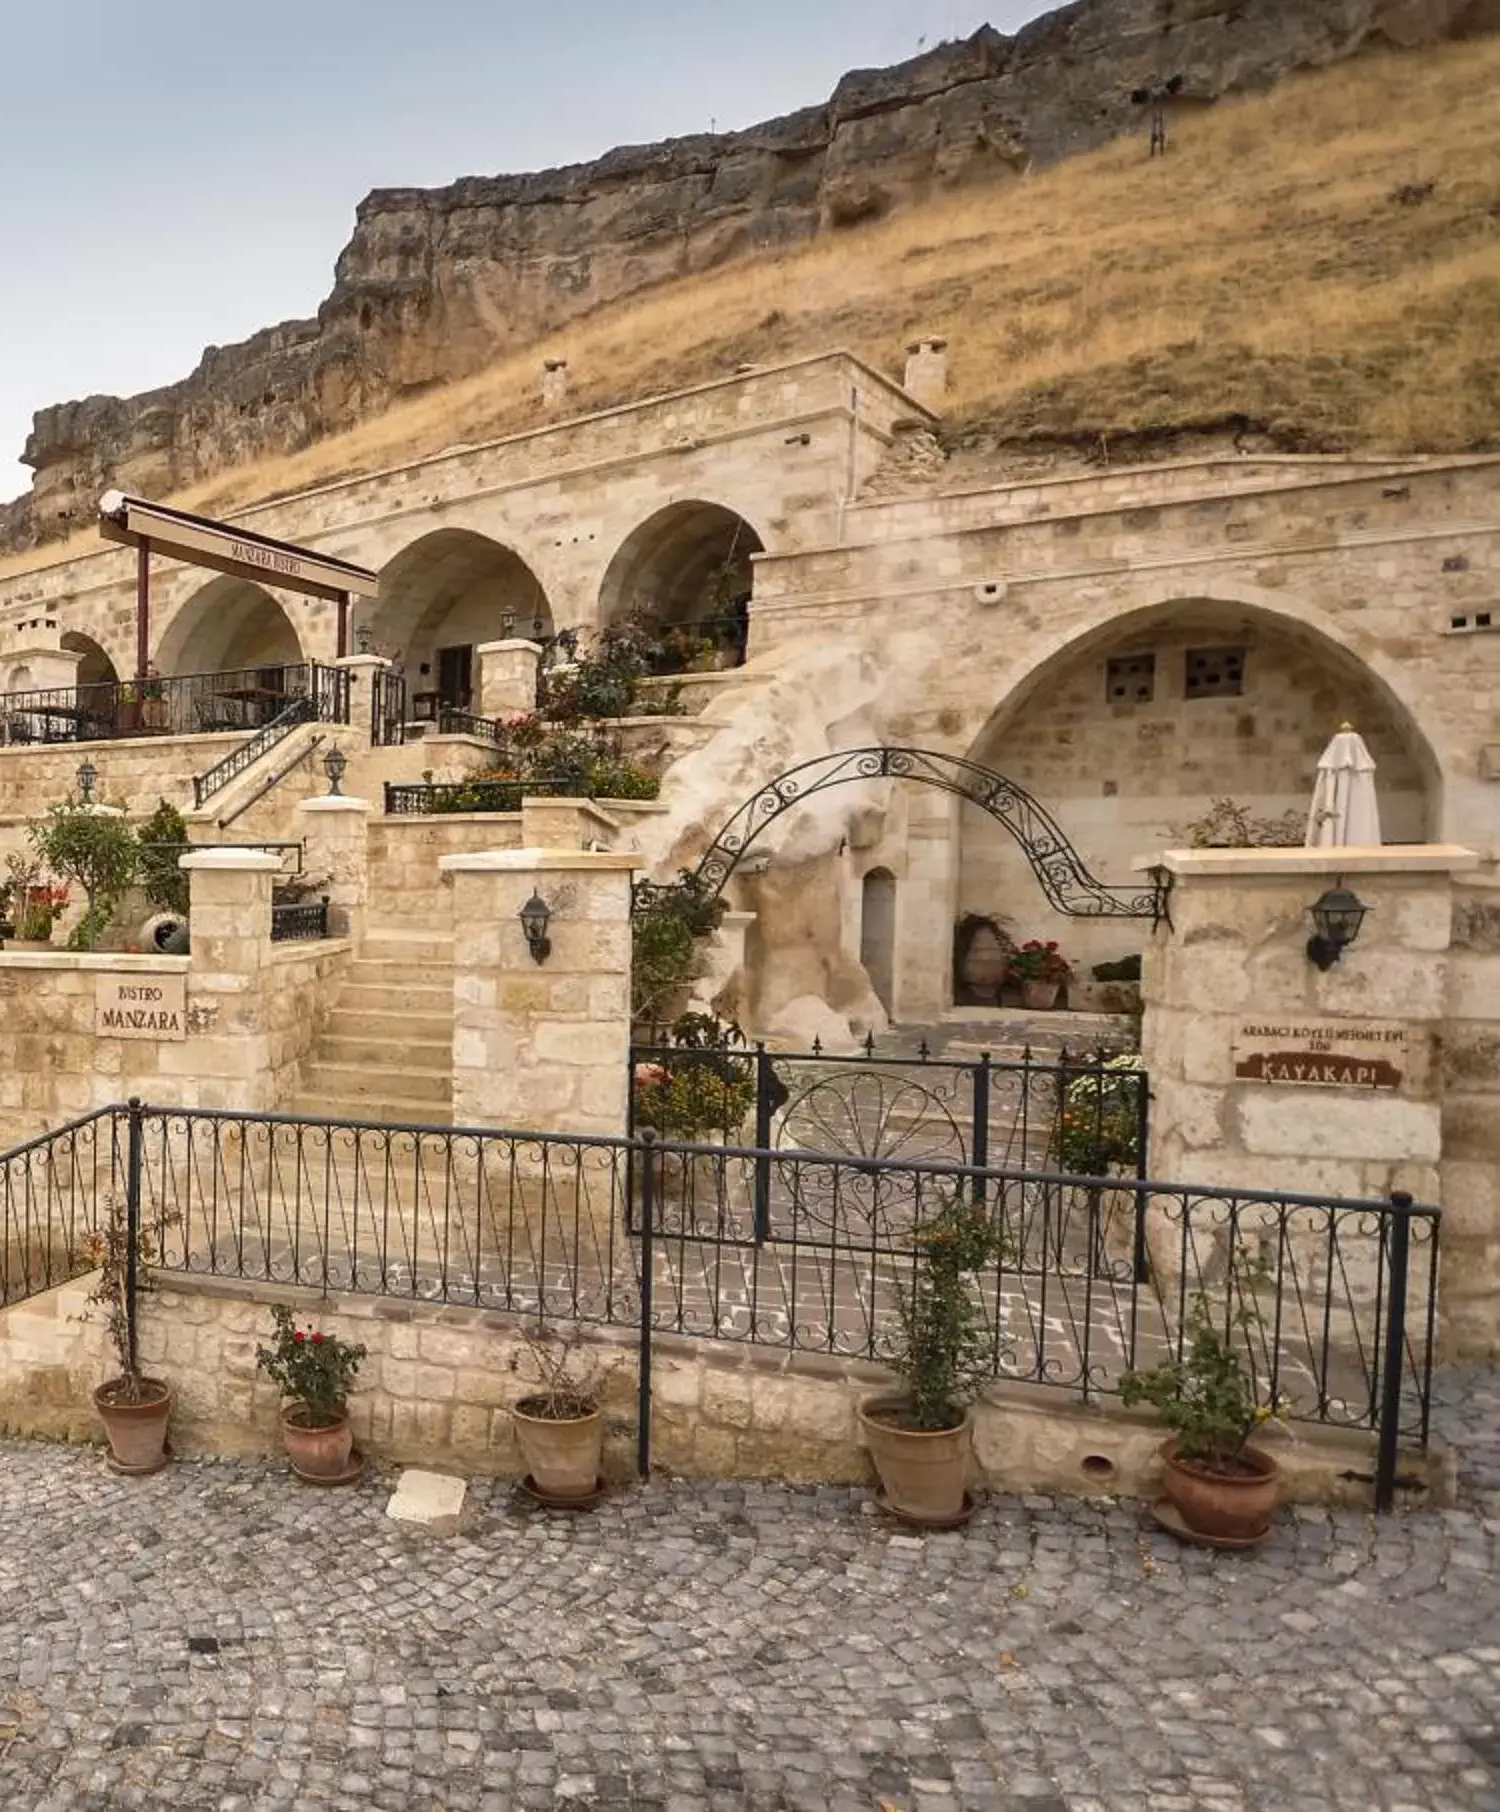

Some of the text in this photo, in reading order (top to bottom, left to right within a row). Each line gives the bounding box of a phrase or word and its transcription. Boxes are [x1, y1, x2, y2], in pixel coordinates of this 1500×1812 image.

[117, 985, 163, 1002] BISTRO
[101, 1008, 179, 1031] MANZARA
[1261, 1061, 1377, 1084] KAYAKAPI
